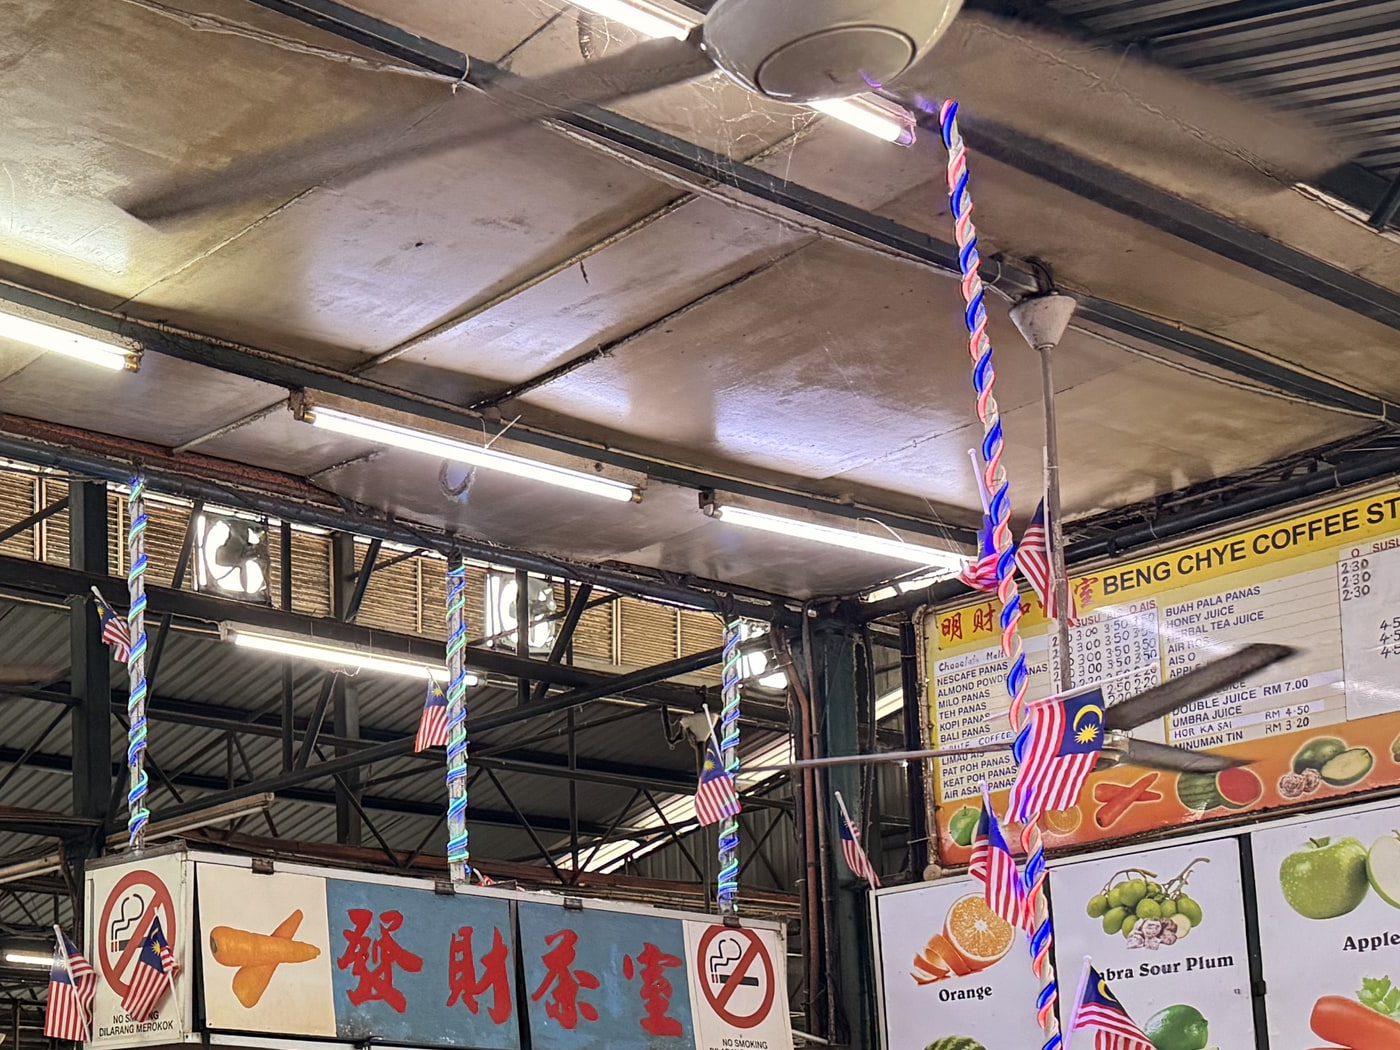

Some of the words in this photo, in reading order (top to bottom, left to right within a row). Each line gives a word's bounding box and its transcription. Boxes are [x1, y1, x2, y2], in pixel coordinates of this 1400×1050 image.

[1102, 562, 1171, 595] BENG
[1177, 540, 1245, 575] CHYE
[1252, 509, 1360, 555] COFFEE
[1140, 600, 1156, 611] AIS
[1165, 603, 1194, 617] BUAH
[1197, 596, 1222, 609] PALA
[1225, 586, 1261, 602] PANAS
[1167, 614, 1201, 629] HONEY
[1204, 605, 1234, 621] JUICE
[1211, 621, 1230, 632] TEA
[1233, 611, 1264, 626] JUICE
[1167, 643, 1185, 654] AIR
[1168, 654, 1185, 666] AIS
[1188, 652, 1196, 661] O
[937, 670, 977, 686] NESCAFE
[979, 663, 1008, 676] PANAS
[938, 682, 974, 698] ALMOND
[977, 673, 1008, 688] POWDE
[938, 697, 963, 709] MILO
[965, 689, 991, 702] PANAS
[1172, 698, 1220, 716] DOUBLE
[1222, 689, 1257, 705] JUICE
[1263, 684, 1281, 696] RM
[1284, 679, 1309, 692] 7.00
[939, 709, 956, 720] TEH
[958, 702, 987, 716] PANAS
[1173, 713, 1209, 728] UMBRA
[1212, 705, 1242, 720] JUICE
[940, 719, 960, 732] KOPI
[1174, 727, 1195, 739] HOR
[1200, 723, 1214, 733] KA
[1217, 721, 1232, 731] SAI
[1265, 710, 1280, 720] RM
[1285, 705, 1310, 717] 4.50
[940, 732, 959, 743] BALI
[962, 724, 991, 738] PANAS
[1174, 734, 1223, 750] MINUMAN
[1226, 731, 1243, 742] TIN
[1265, 722, 1281, 734] RM
[1285, 717, 1310, 731] 3.20
[942, 767, 957, 776] PAT
[960, 761, 978, 772] POH
[981, 755, 1010, 769] PANAS
[943, 777, 964, 788] KEAT
[967, 773, 985, 783] POH
[988, 765, 1017, 778] PANAS
[944, 789, 959, 800] AIR
[1342, 931, 1400, 952] Apple
[338, 908, 683, 1036] 發財茶室
[1099, 967, 1134, 982] bra
[1139, 962, 1181, 977] Sour
[1185, 955, 1234, 971] Plum
[938, 986, 993, 1002] Orange
[99, 1024, 134, 1037] DILARANG
[136, 1020, 174, 1032] MEROKOK
[113, 1014, 124, 1024] NO
[722, 1039, 732, 1047] NO
[734, 1040, 768, 1049] SMOKING
